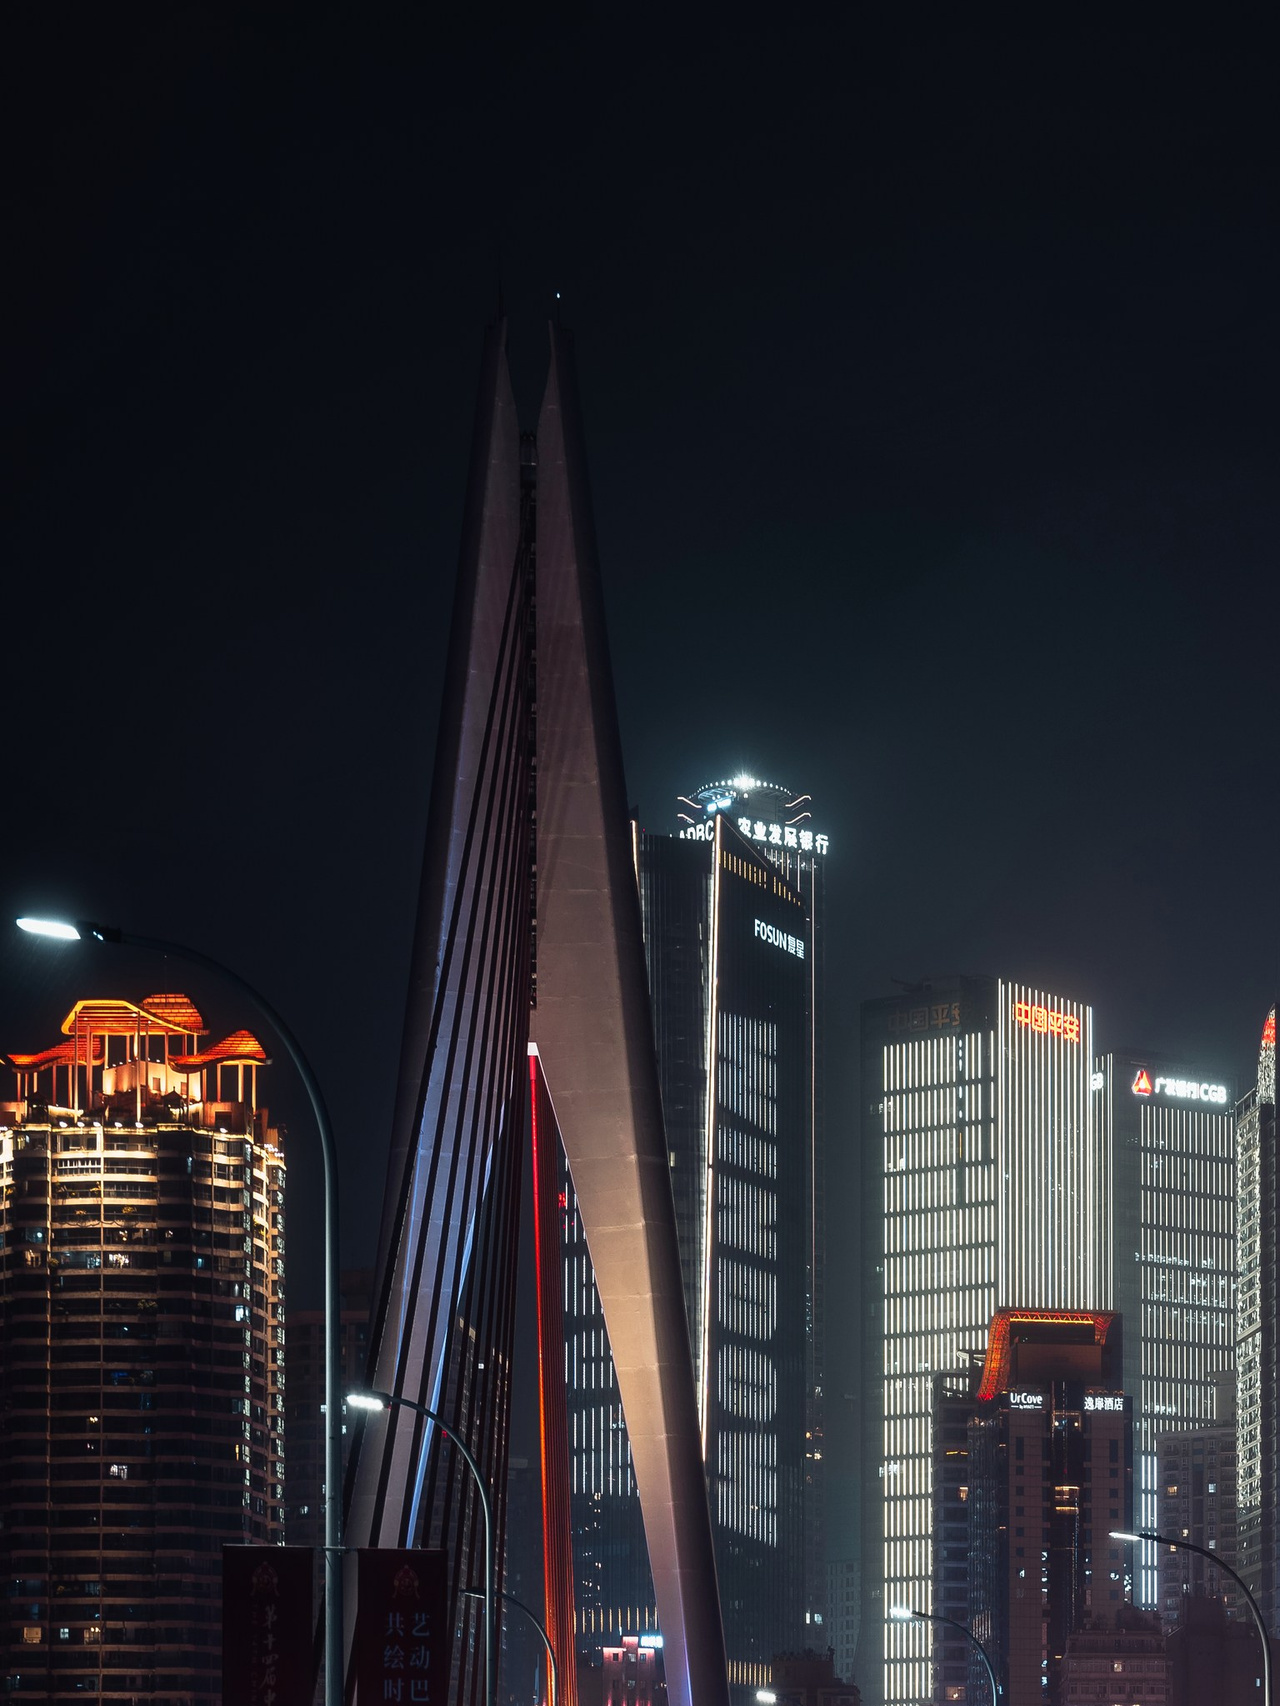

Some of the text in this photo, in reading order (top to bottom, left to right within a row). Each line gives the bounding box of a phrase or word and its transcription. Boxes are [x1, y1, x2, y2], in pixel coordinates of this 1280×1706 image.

[737, 816, 829, 855] 农业发展银行
[1015, 1001, 1079, 1043] 中国平安
[1200, 1083, 1228, 1103] CGB
[1010, 1392, 1043, 1405] UrCove
